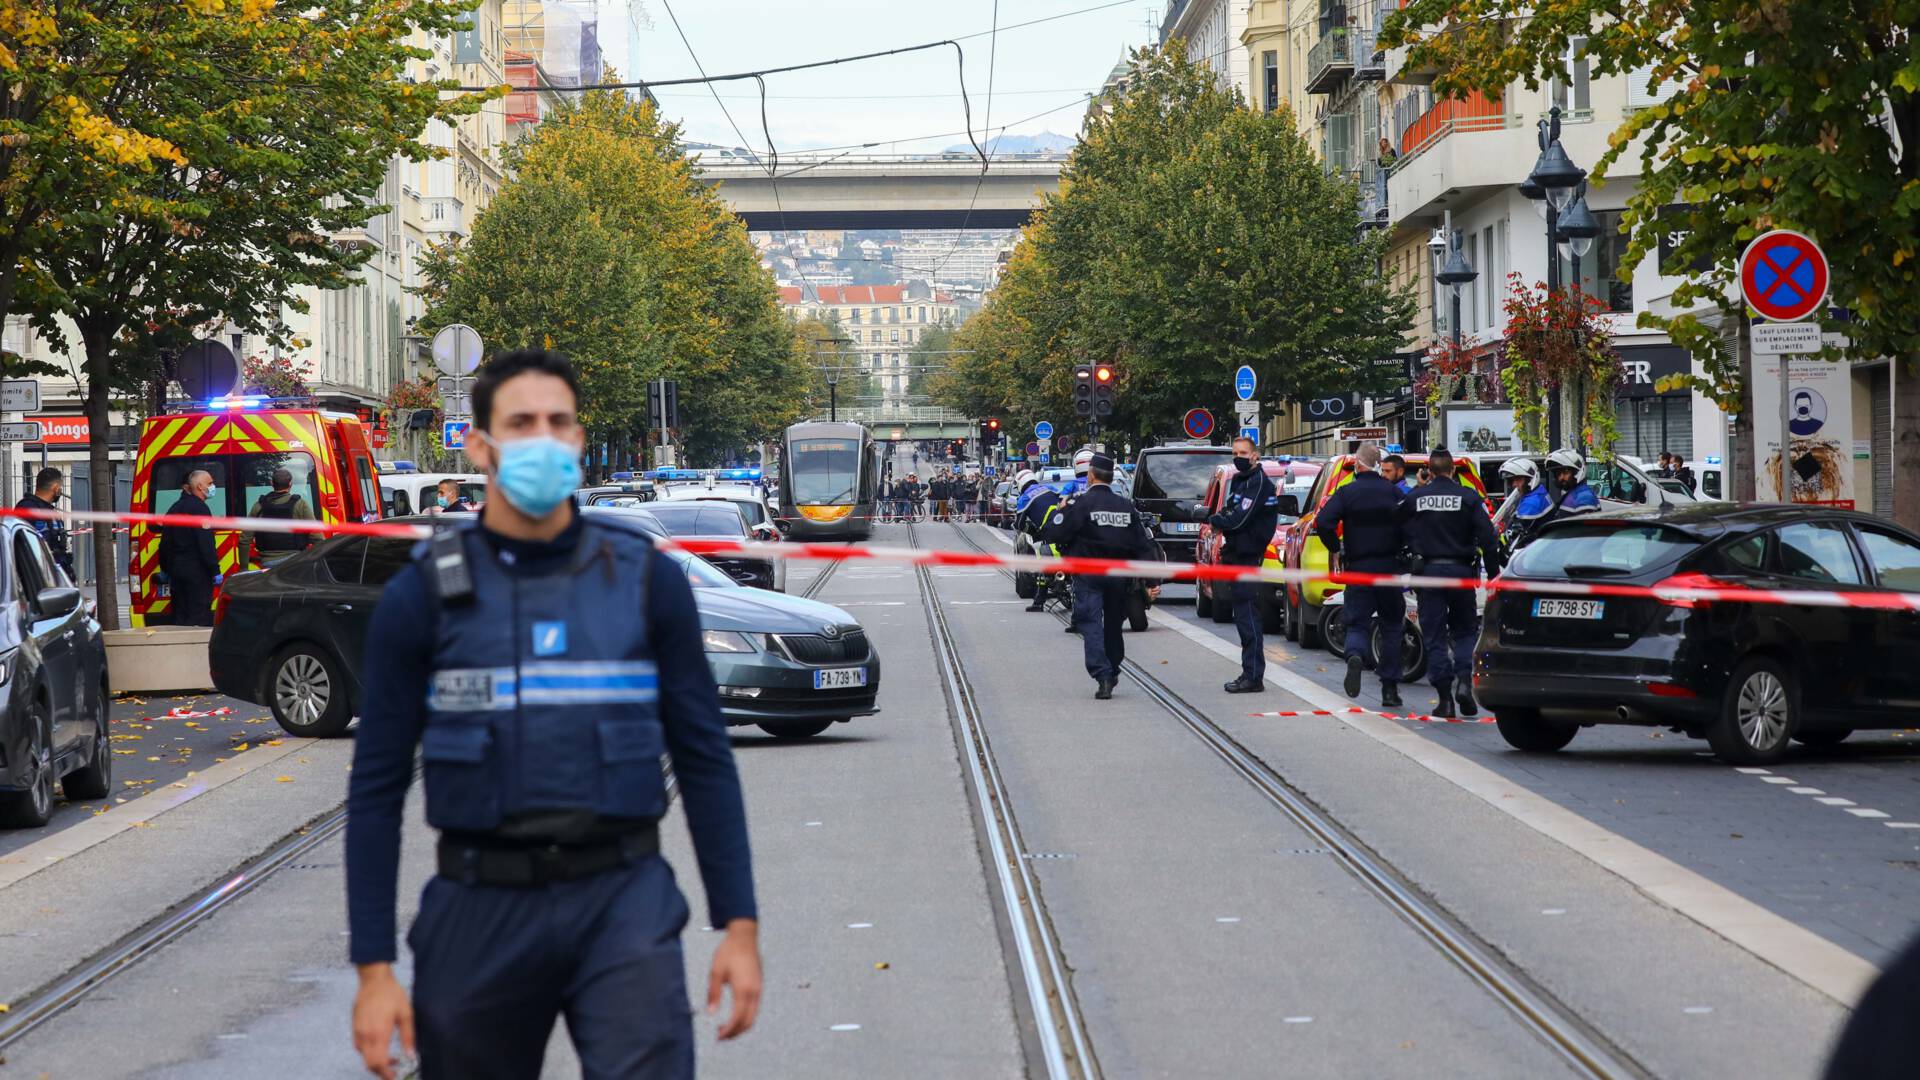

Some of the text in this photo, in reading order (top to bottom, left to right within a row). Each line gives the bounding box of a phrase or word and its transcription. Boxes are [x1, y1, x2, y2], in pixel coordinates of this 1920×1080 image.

[1668, 231, 1695, 247] SF
[1621, 360, 1653, 384] FR
[1419, 496, 1459, 509] POLICE
[1093, 513, 1129, 525] POLICE
